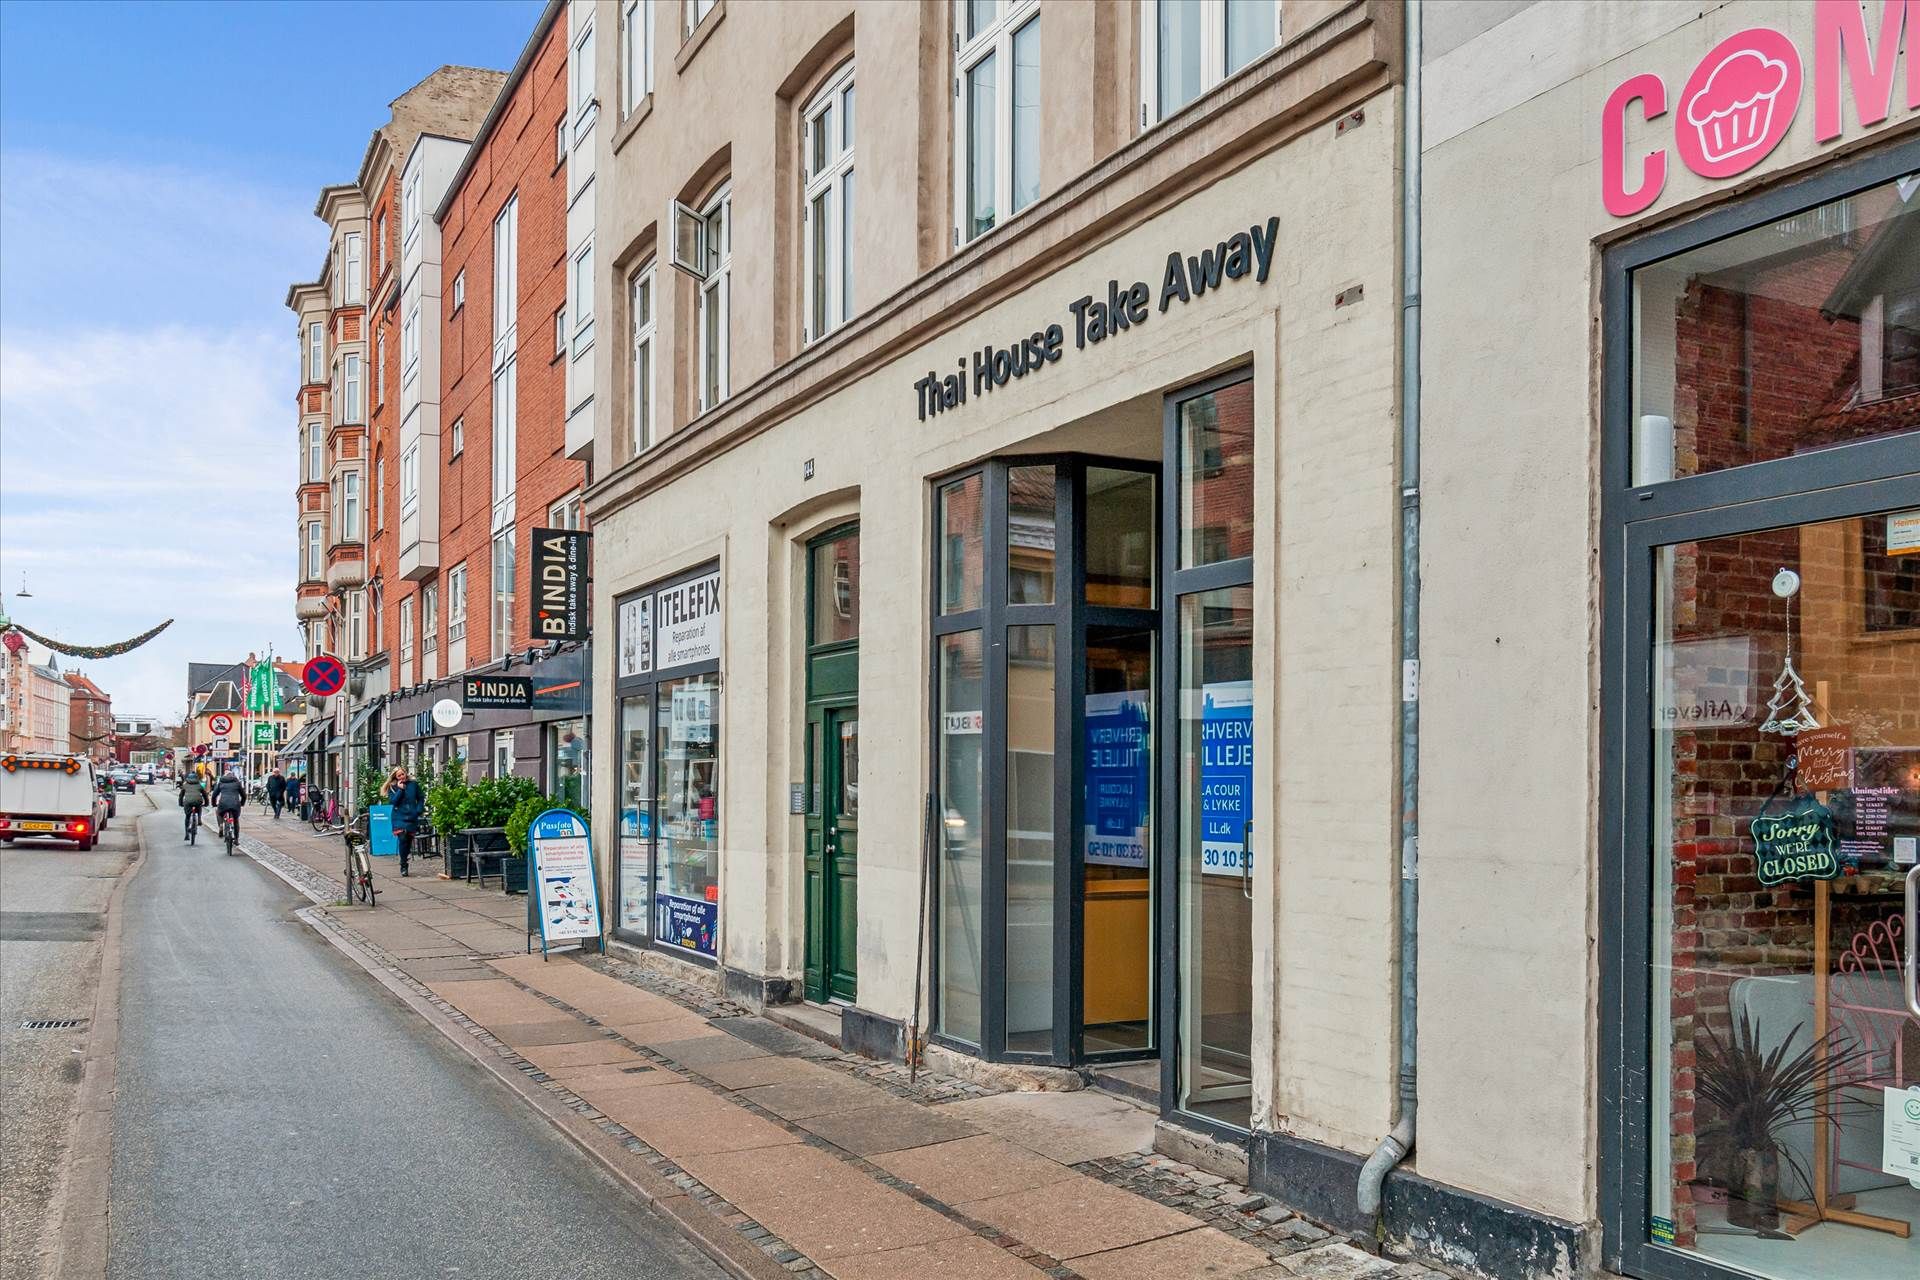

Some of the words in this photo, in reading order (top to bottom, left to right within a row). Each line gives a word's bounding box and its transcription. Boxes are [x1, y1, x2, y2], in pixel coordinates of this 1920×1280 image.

[913, 357, 967, 421] Thai
[973, 323, 1063, 397] House
[1069, 279, 1149, 349] Take
[1158, 216, 1280, 312] Away
[569, 572, 578, 592] away
[568, 594, 576, 610] take
[659, 576, 720, 629] ITELEFIX
[672, 626, 699, 644] Reparation
[677, 645, 711, 661] smartphones
[1217, 745, 1252, 766] LEJE
[1797, 746, 1848, 765] Merry
[1795, 766, 1855, 788] Christmas
[1213, 784, 1241, 796] COUR
[1203, 799, 1209, 811] &
[1212, 799, 1241, 811] LYKKE
[541, 821, 572, 832] Passfoto
[1209, 822, 1231, 835] LL.dk
[1762, 823, 1821, 841] Sorry
[1775, 840, 1810, 856] WE'RE
[1204, 849, 1219, 866] 30
[1222, 850, 1237, 867] 10
[1763, 853, 1830, 877] CLOSED
[669, 899, 691, 911] Reparation
[673, 911, 701, 923] smartphones
